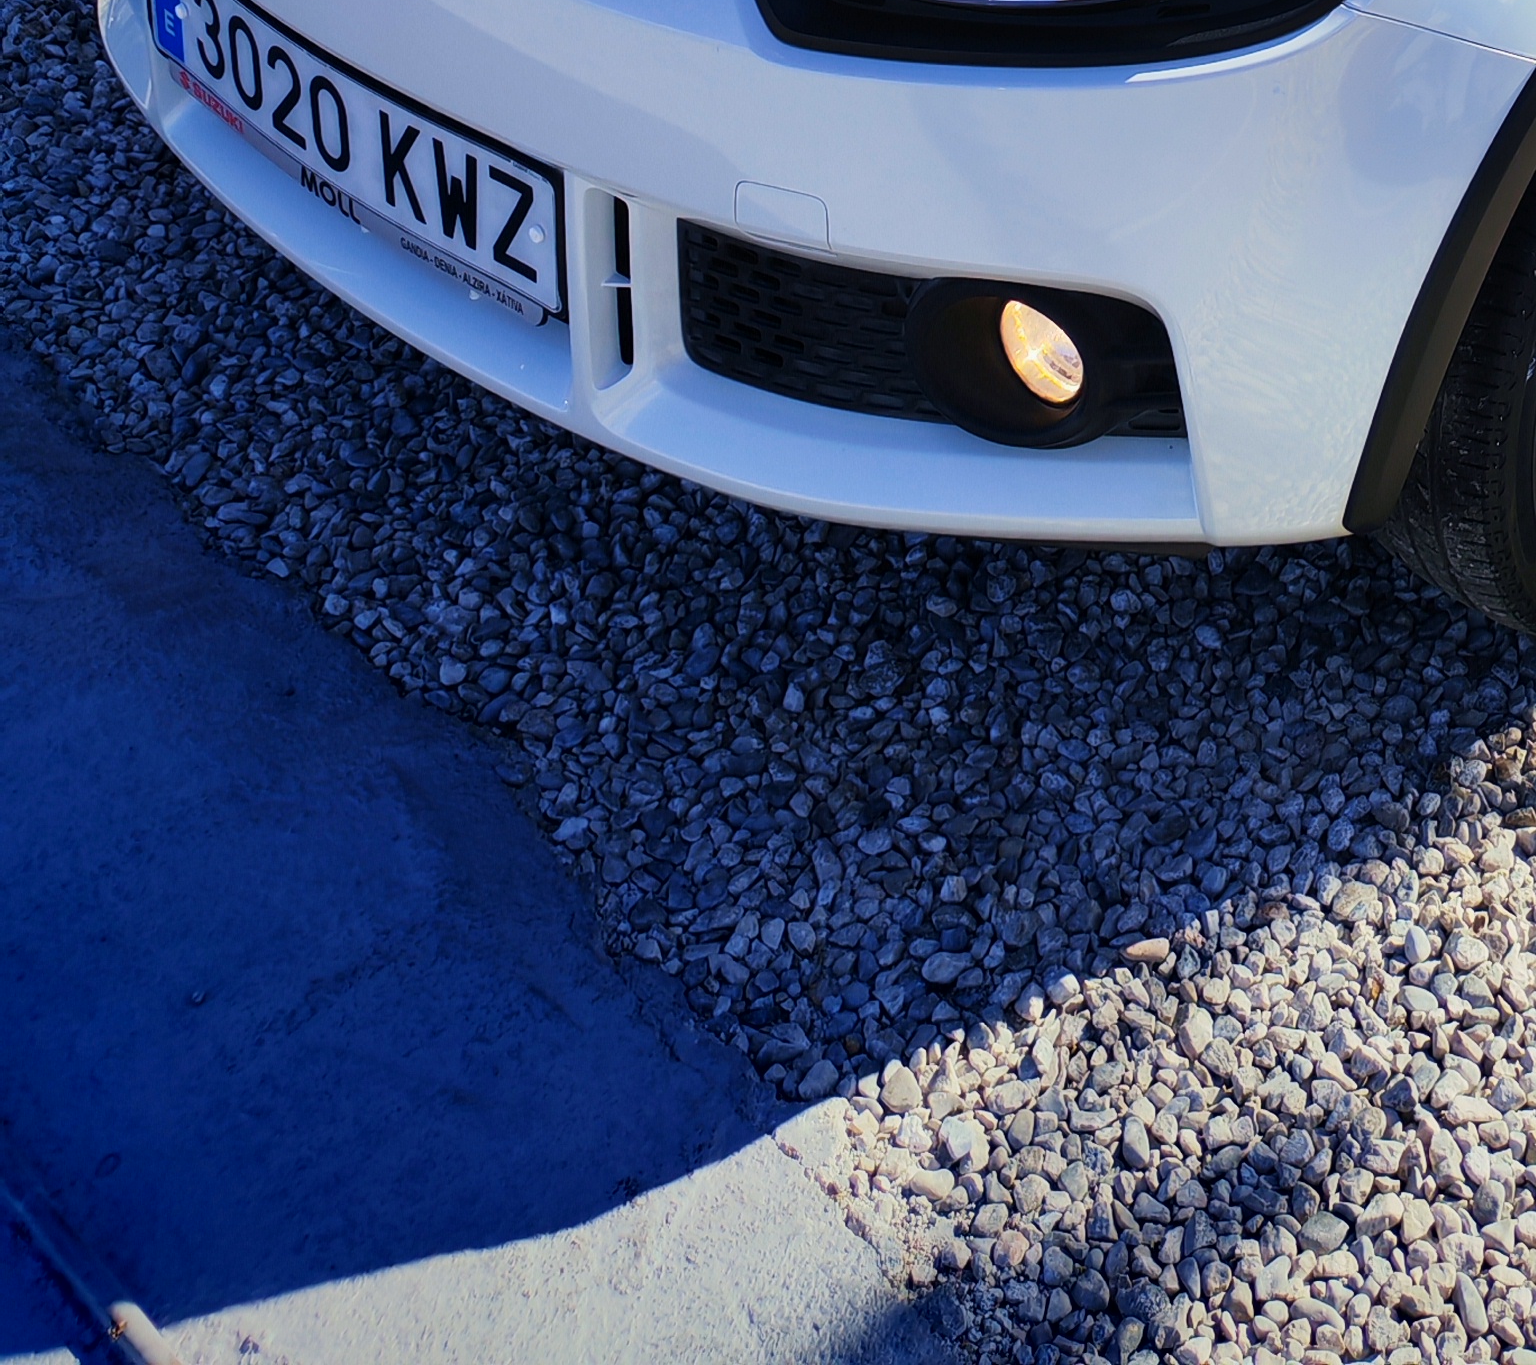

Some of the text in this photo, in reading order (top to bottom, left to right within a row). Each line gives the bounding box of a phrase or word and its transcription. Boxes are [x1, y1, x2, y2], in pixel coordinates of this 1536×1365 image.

[163, 7, 176, 38] E
[193, 80, 244, 135] SUZUKI
[300, 164, 361, 226] MOLL
[378, 108, 538, 284] KWZ
[400, 236, 430, 263] GANDIA
[434, 255, 459, 279] DENIA
